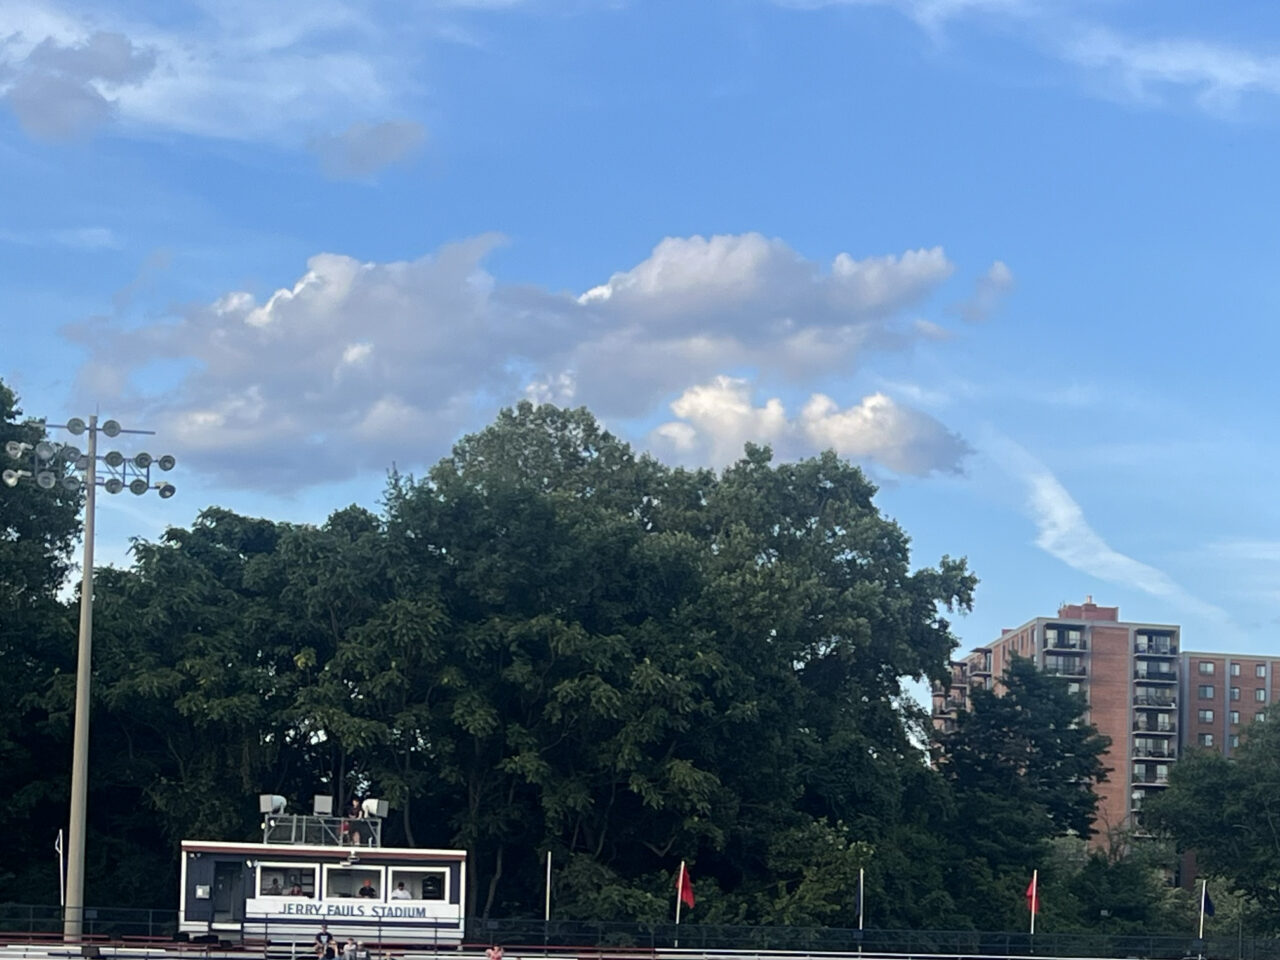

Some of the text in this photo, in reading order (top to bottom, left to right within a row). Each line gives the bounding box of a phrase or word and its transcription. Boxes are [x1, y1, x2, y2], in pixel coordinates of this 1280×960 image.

[278, 903, 427, 918] JERRY FAULS STADIUM
